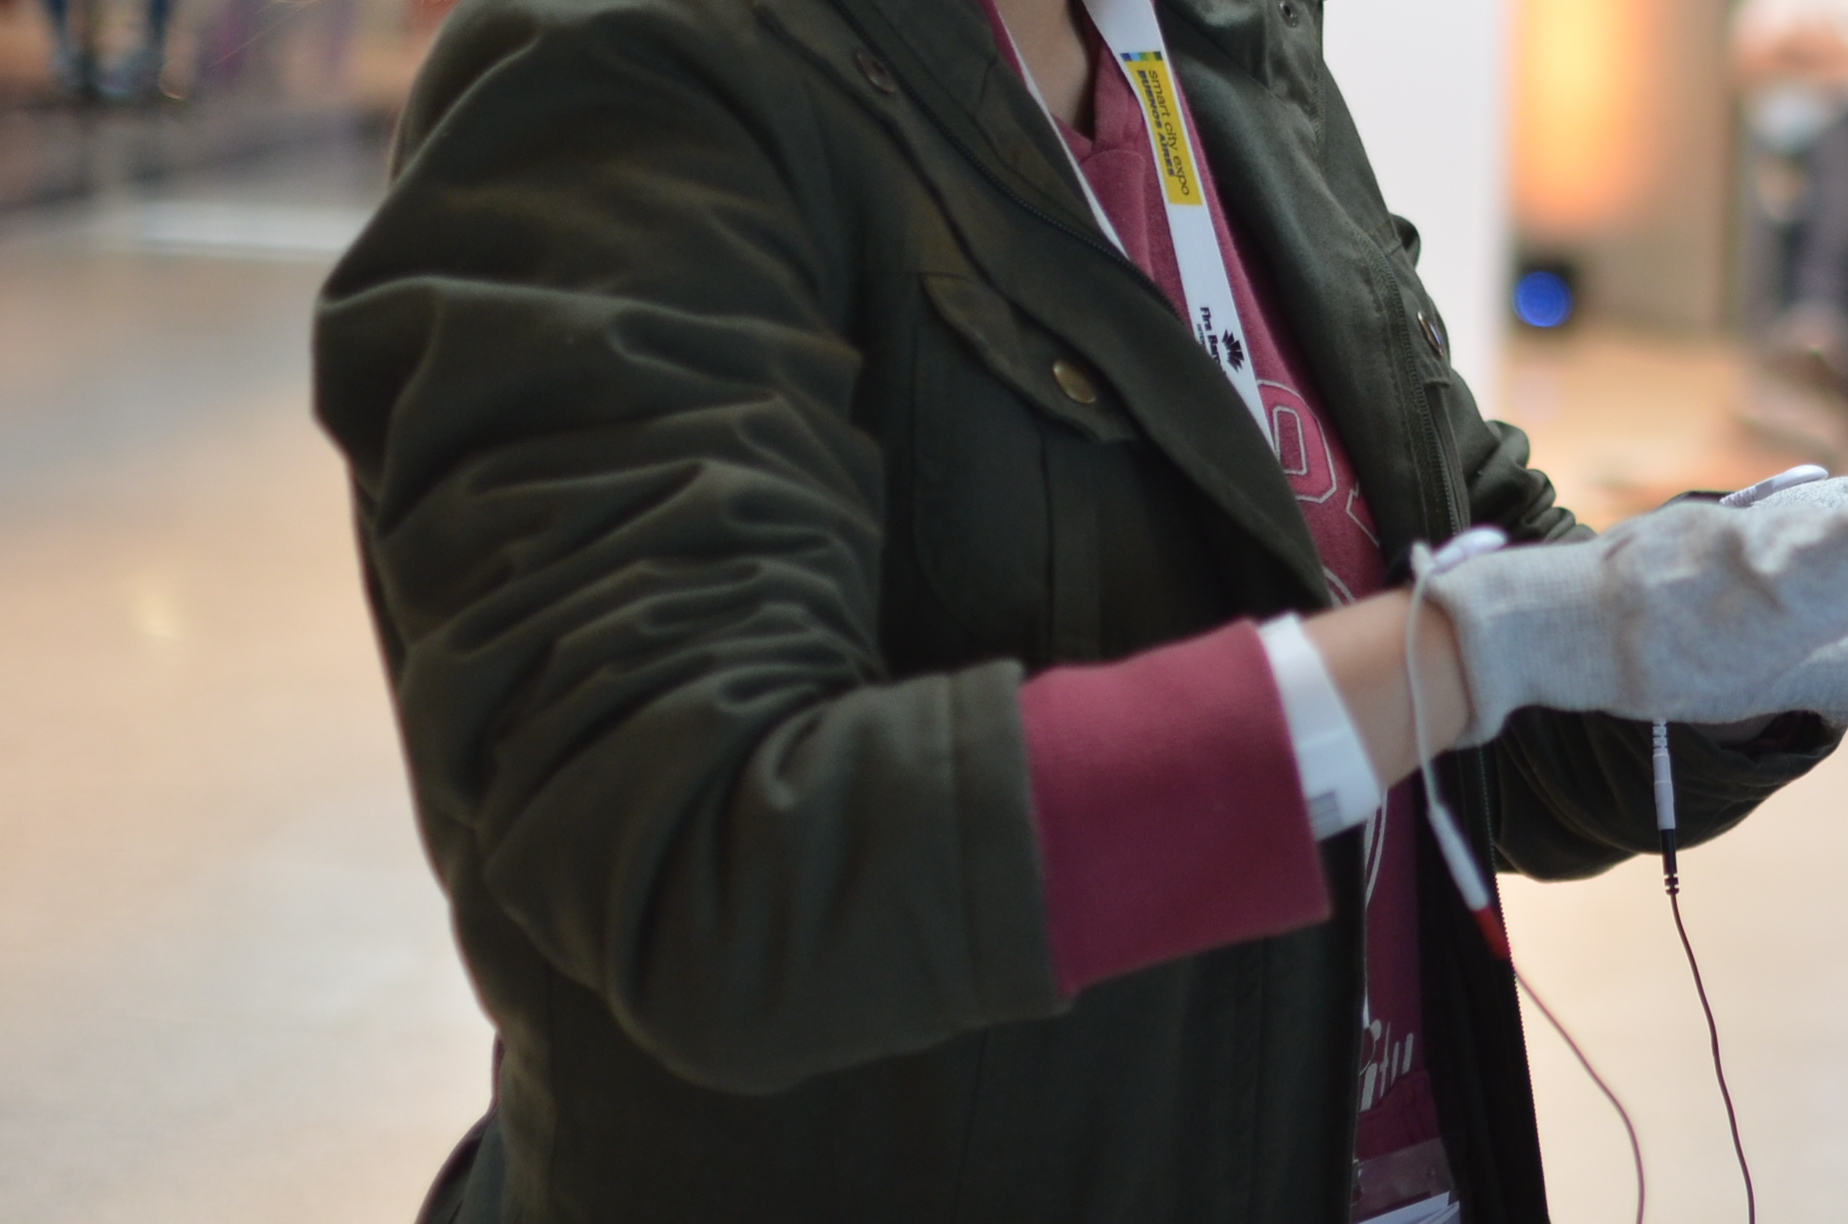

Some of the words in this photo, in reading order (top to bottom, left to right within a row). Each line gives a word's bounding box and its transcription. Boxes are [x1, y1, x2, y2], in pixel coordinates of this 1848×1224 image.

[1137, 70, 1163, 129] BUENOS
[1158, 132, 1176, 177] AIRES
[1148, 70, 1170, 117] smart
[1165, 122, 1178, 150] city
[1173, 155, 1190, 196] expo
